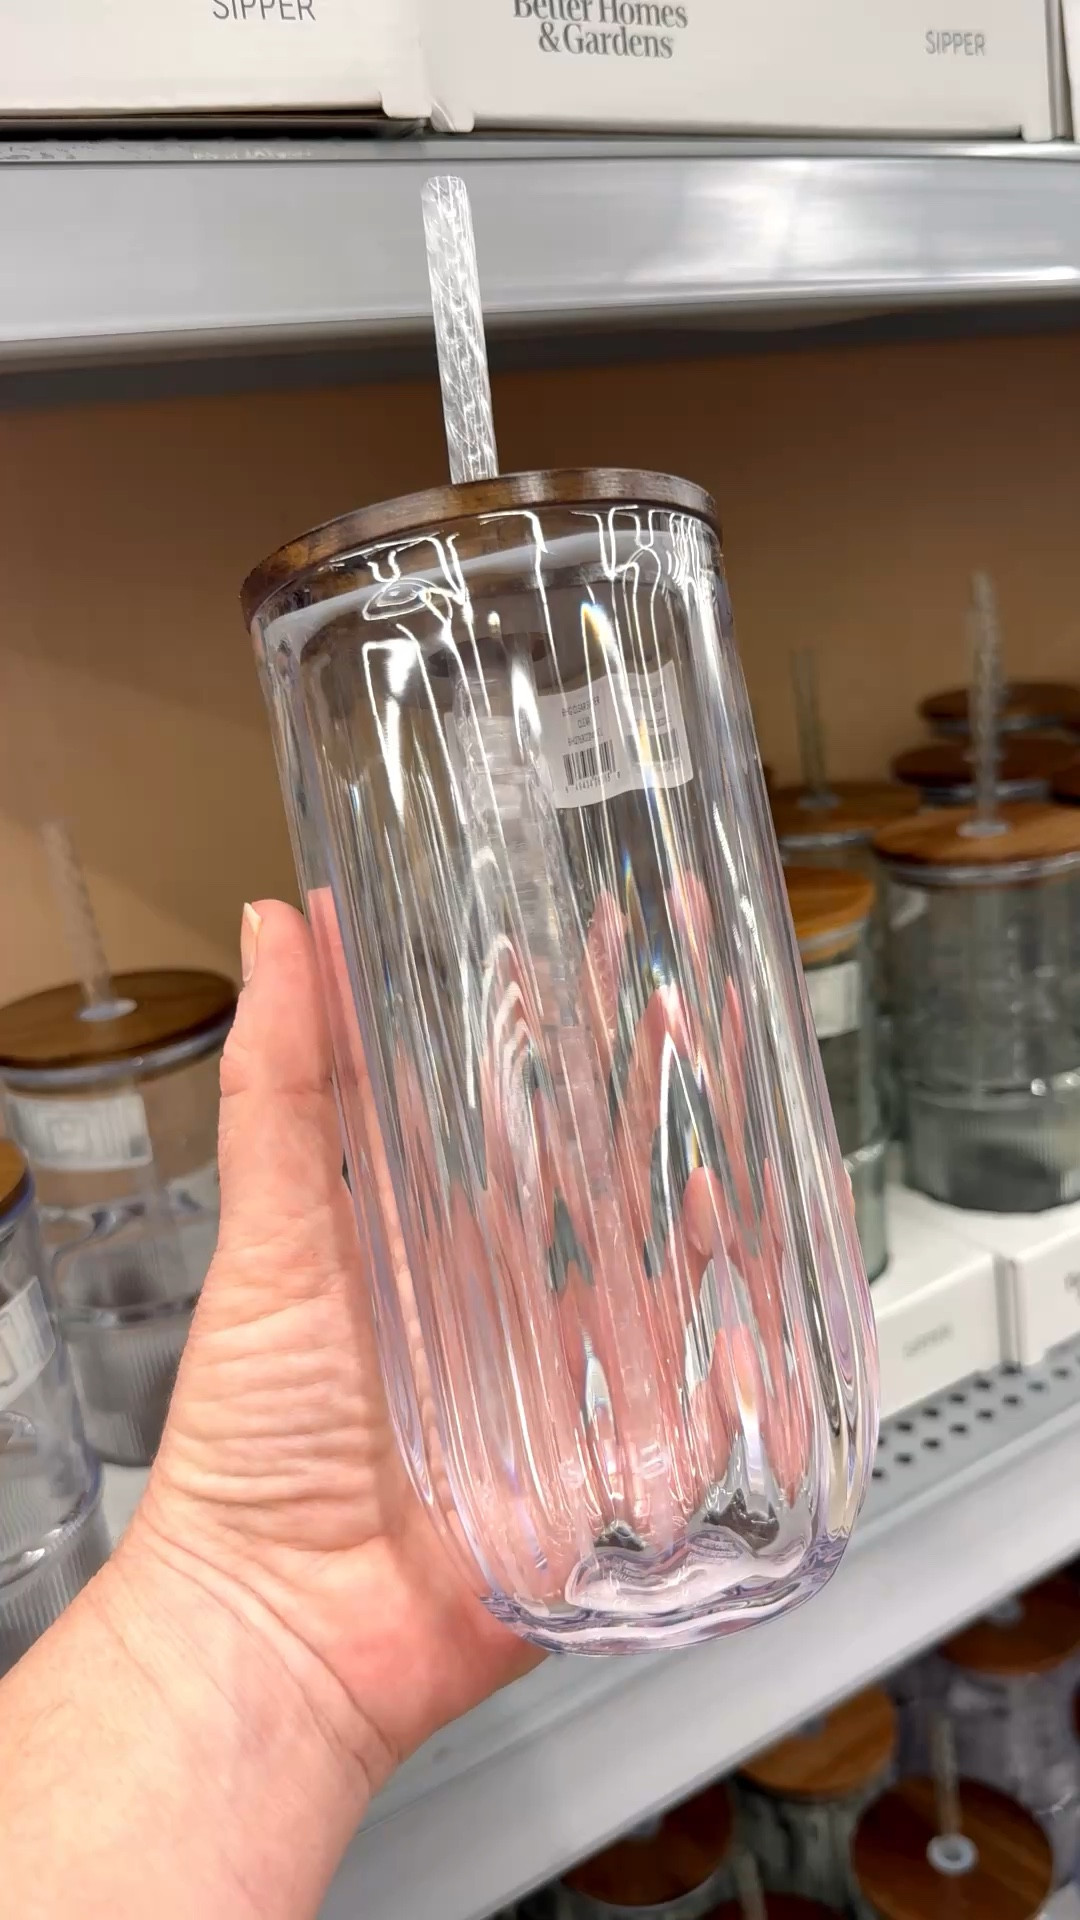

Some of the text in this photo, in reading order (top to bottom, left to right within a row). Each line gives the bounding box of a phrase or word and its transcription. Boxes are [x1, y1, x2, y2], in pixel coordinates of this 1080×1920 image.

[213, 0, 316, 21] SIPPER
[513, 0, 688, 28] Better Homes
[925, 30, 986, 56] SIPPER
